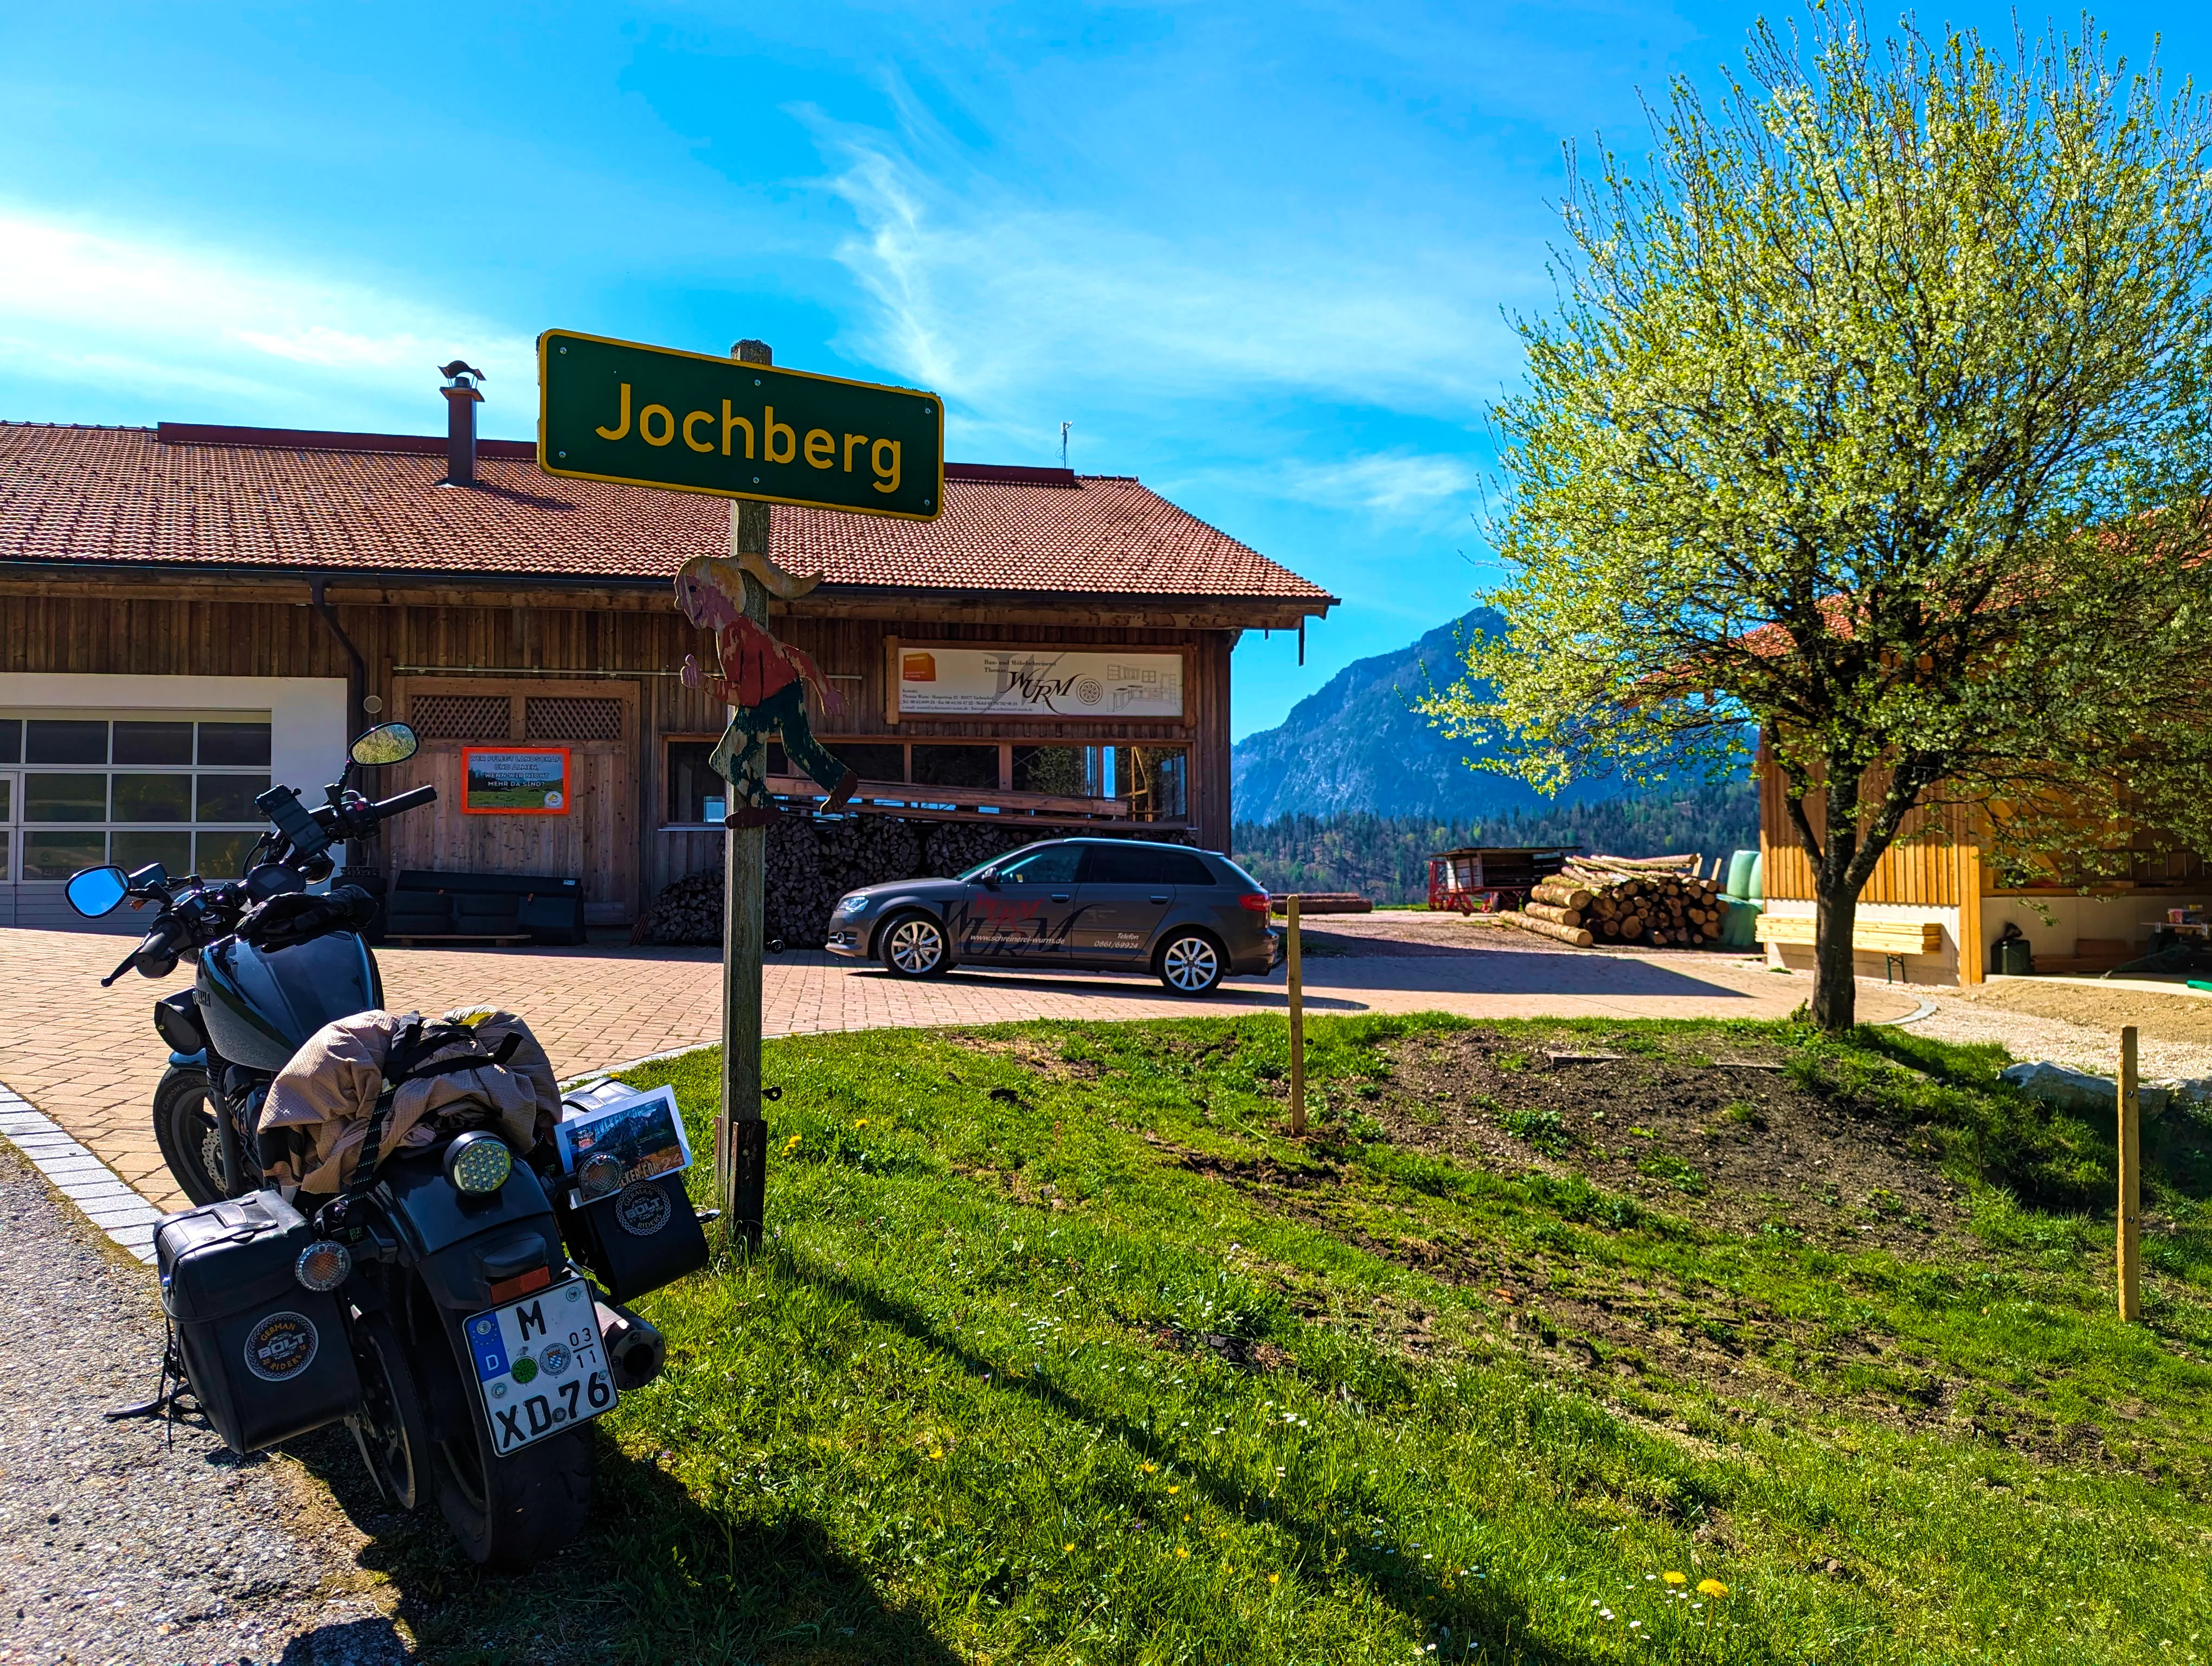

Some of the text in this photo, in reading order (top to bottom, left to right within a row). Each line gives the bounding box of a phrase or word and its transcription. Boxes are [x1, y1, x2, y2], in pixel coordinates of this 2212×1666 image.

[595, 382, 902, 494] Jochberg
[999, 668, 1086, 715] WURM
[931, 899, 1105, 958] WURM
[970, 934, 1065, 945] www.schreinerei-wurm.de
[1094, 940, 1139, 950] 0861/69924
[162, 1082, 187, 1110] CHROME
[624, 1189, 654, 1206] GERMAN
[625, 1197, 660, 1219] BOLT
[637, 1214, 663, 1229] RIDERS
[516, 1300, 547, 1342] M
[260, 1323, 296, 1341] GERMAN
[569, 1327, 592, 1347] 03
[258, 1332, 306, 1359] BOLT
[269, 1354, 302, 1370] RIDERS
[485, 1354, 499, 1372] D
[576, 1350, 597, 1369] 11
[494, 1372, 610, 1449] XD 76
